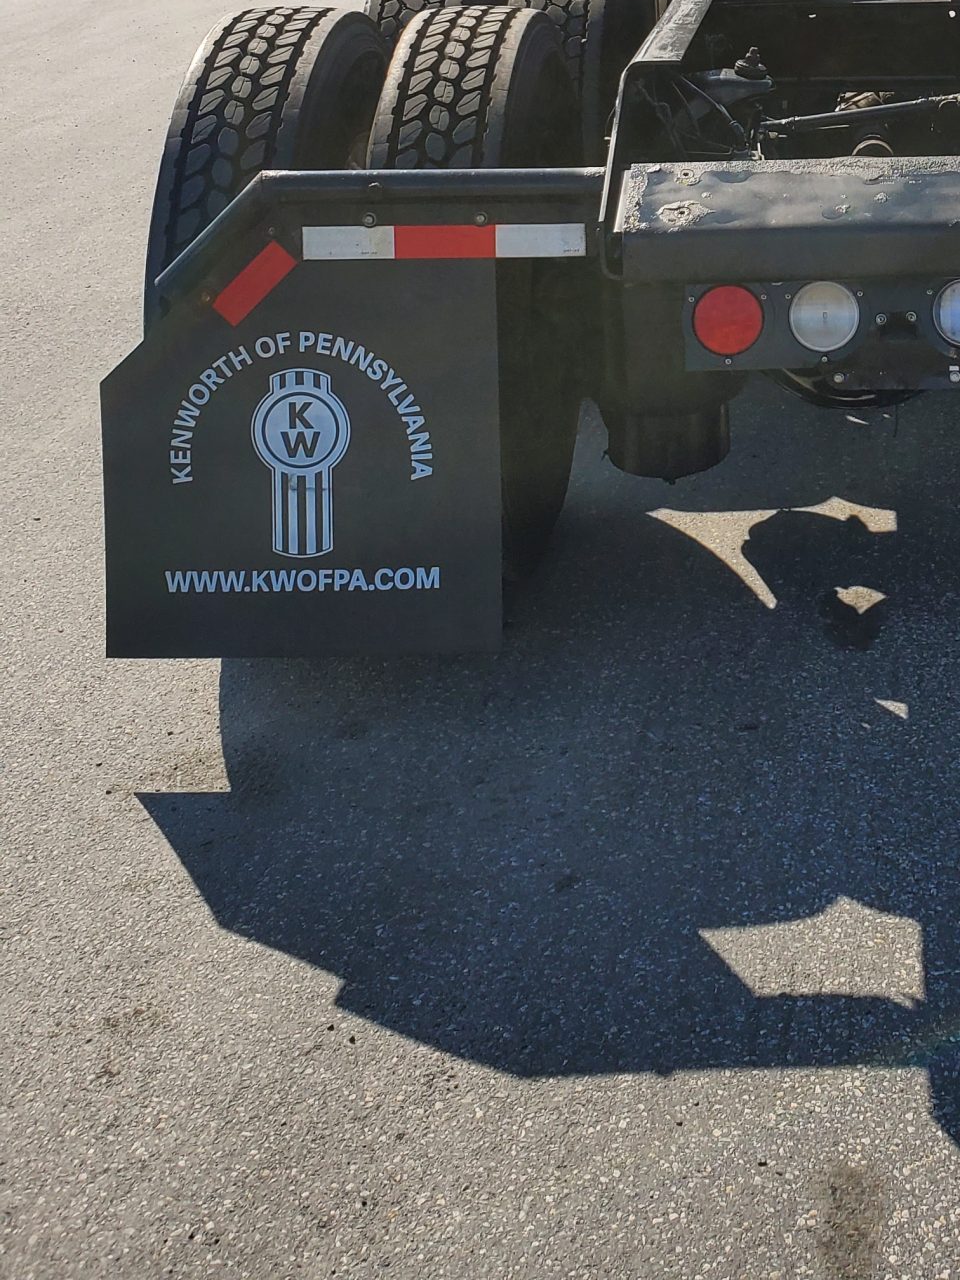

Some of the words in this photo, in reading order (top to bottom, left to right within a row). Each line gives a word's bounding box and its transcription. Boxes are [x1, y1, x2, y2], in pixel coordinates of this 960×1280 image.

[170, 345, 253, 484] KENWORTH
[254, 332, 291, 359] OF
[299, 331, 433, 481] PENNSYLVANIA
[165, 566, 440, 593] WWW.KWOFPA.COM
